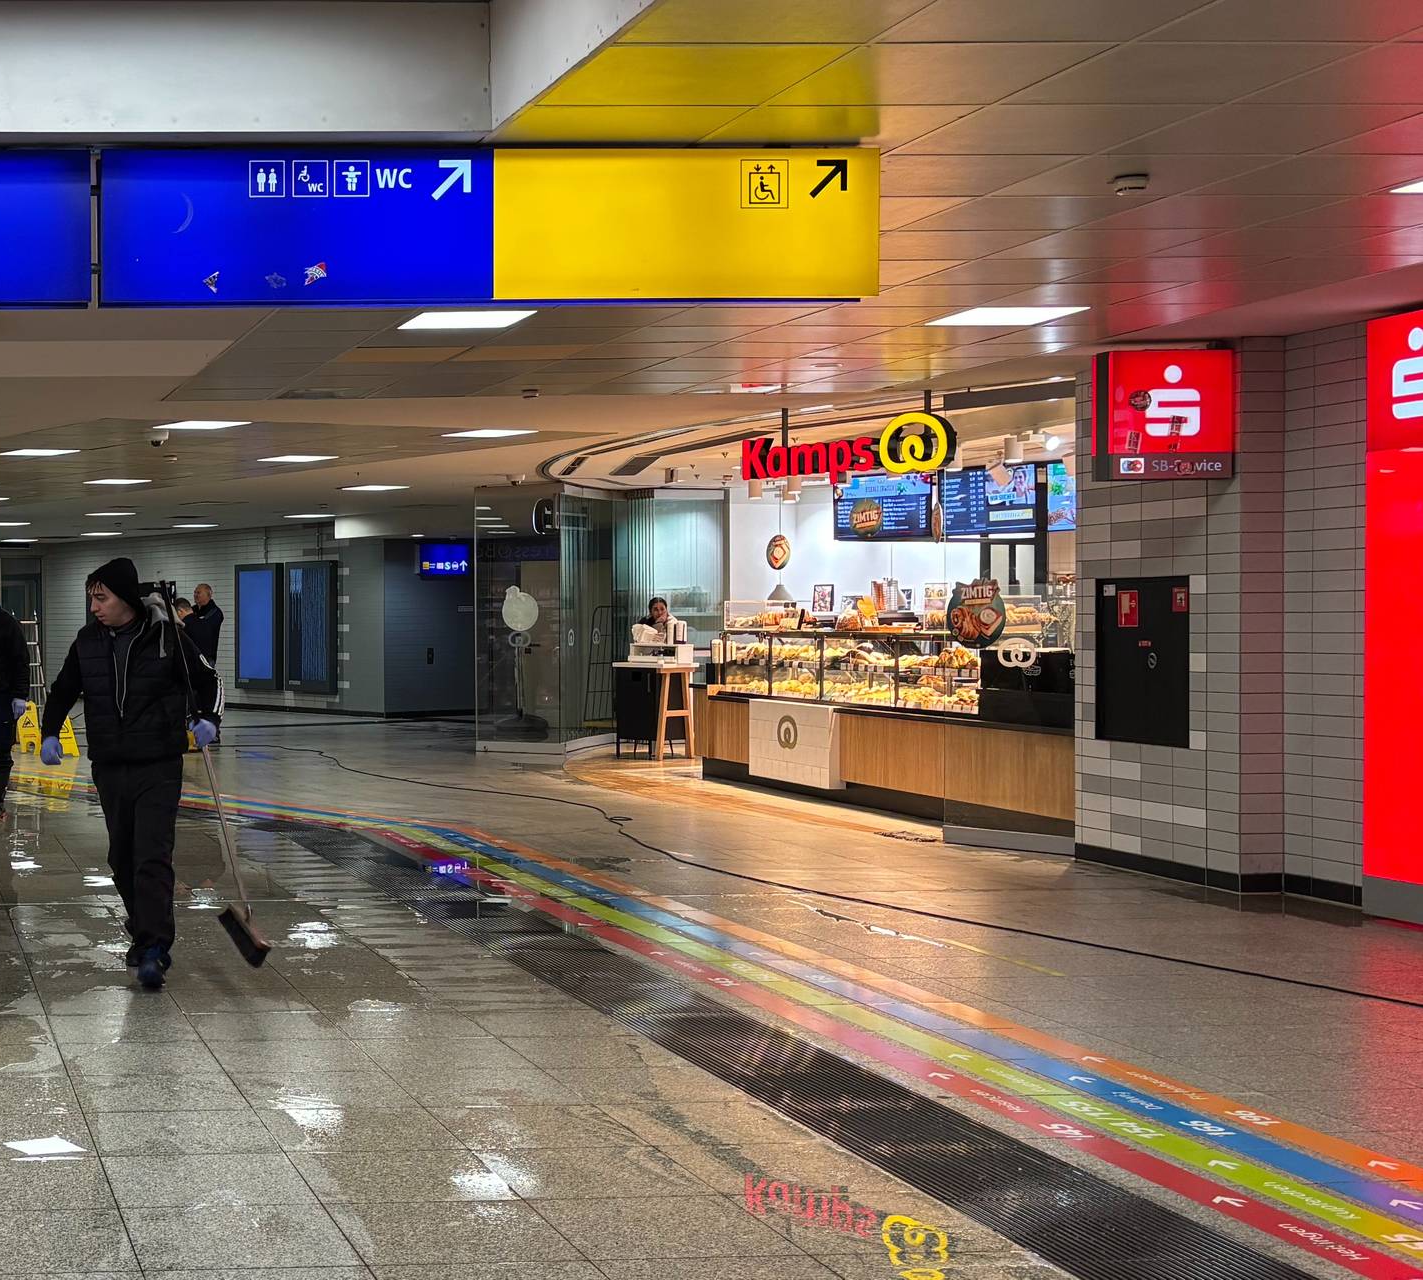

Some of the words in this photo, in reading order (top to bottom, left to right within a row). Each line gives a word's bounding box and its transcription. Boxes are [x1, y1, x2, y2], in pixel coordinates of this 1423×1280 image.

[375, 168, 412, 189] WC
[307, 183, 324, 192] WC
[742, 436, 876, 485] Kamps
[852, 510, 879, 524] ZIMTIG
[961, 585, 993, 599] ZIMTIG
[1226, 1110, 1281, 1126] 196
[1039, 1122, 1095, 1139] 145
[1179, 1119, 1236, 1138] 166
